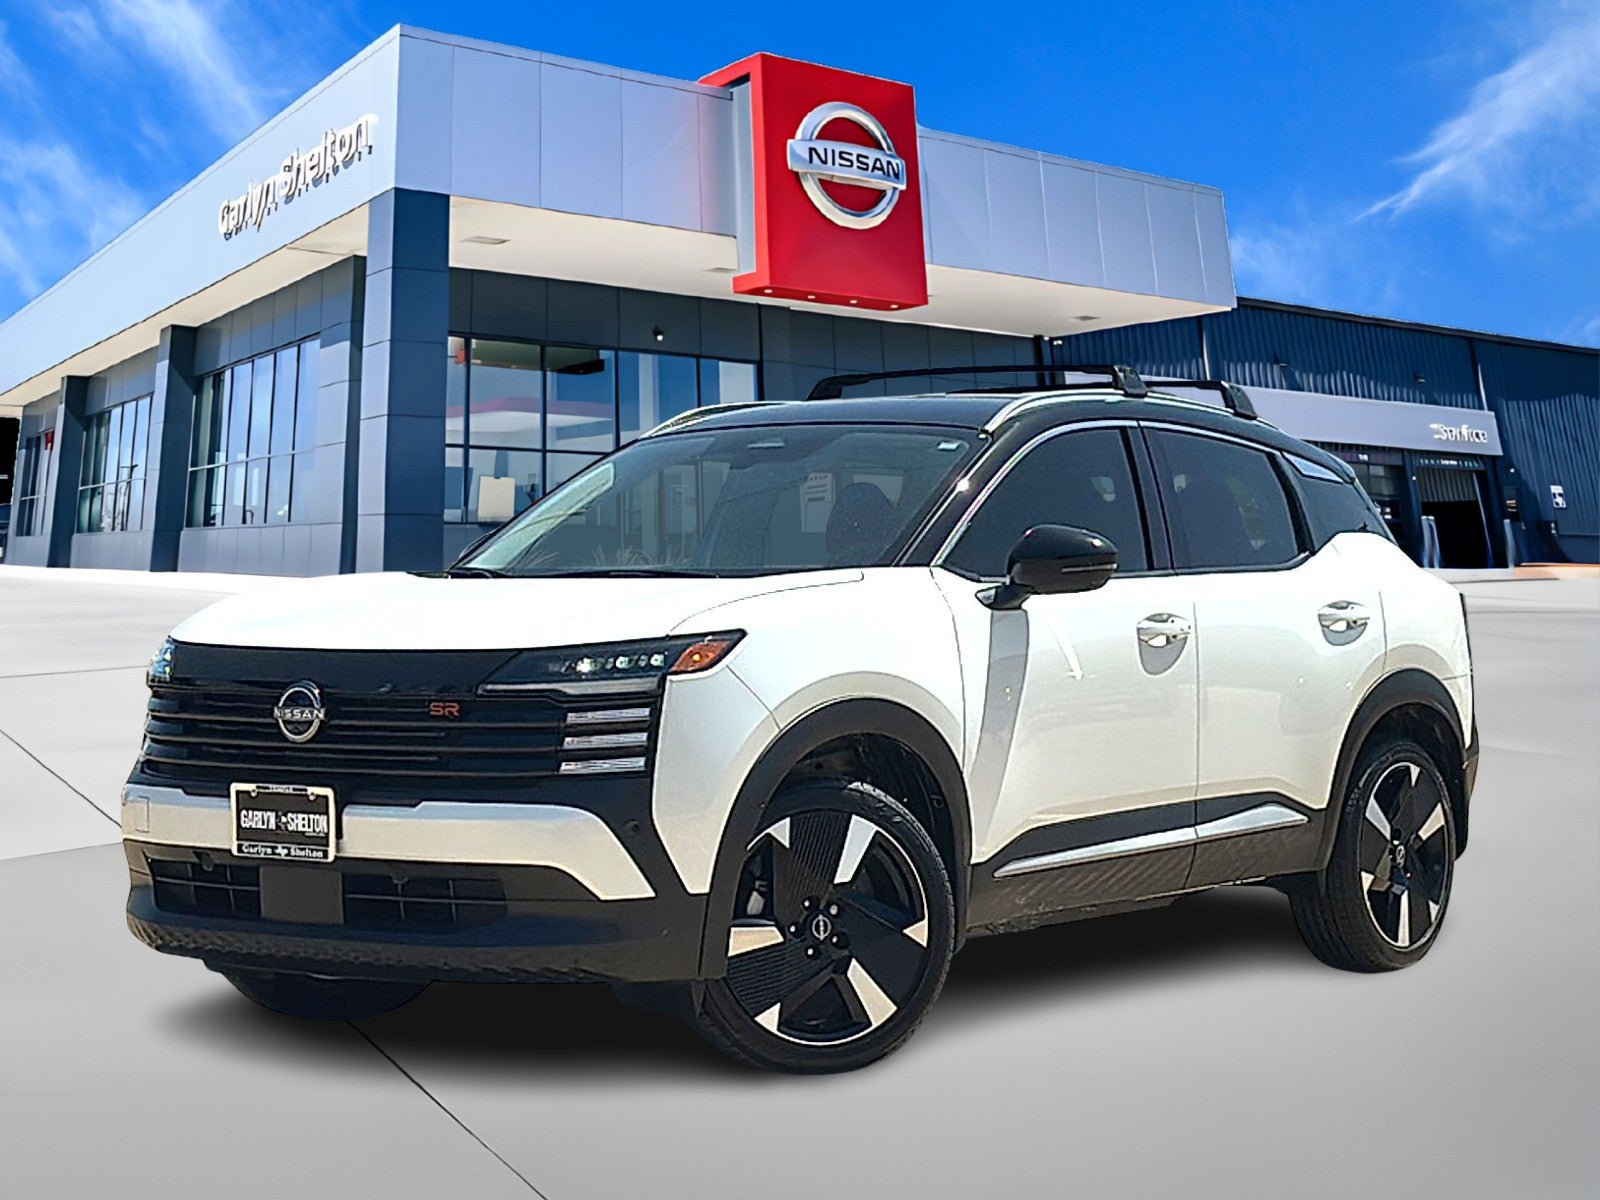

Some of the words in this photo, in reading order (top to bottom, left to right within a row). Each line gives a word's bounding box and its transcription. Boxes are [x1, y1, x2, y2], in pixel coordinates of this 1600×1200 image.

[808, 146, 901, 181] NISSAN
[218, 181, 278, 233] Garlyn
[278, 115, 373, 201] Shelton
[1430, 423, 1488, 443] Service
[273, 706, 326, 720] NISSAN
[429, 702, 460, 717] SR
[240, 809, 277, 831] GARLYN
[287, 812, 328, 834] SHELTON
[242, 844, 273, 858] Garlyn
[290, 846, 324, 858] Shelton
